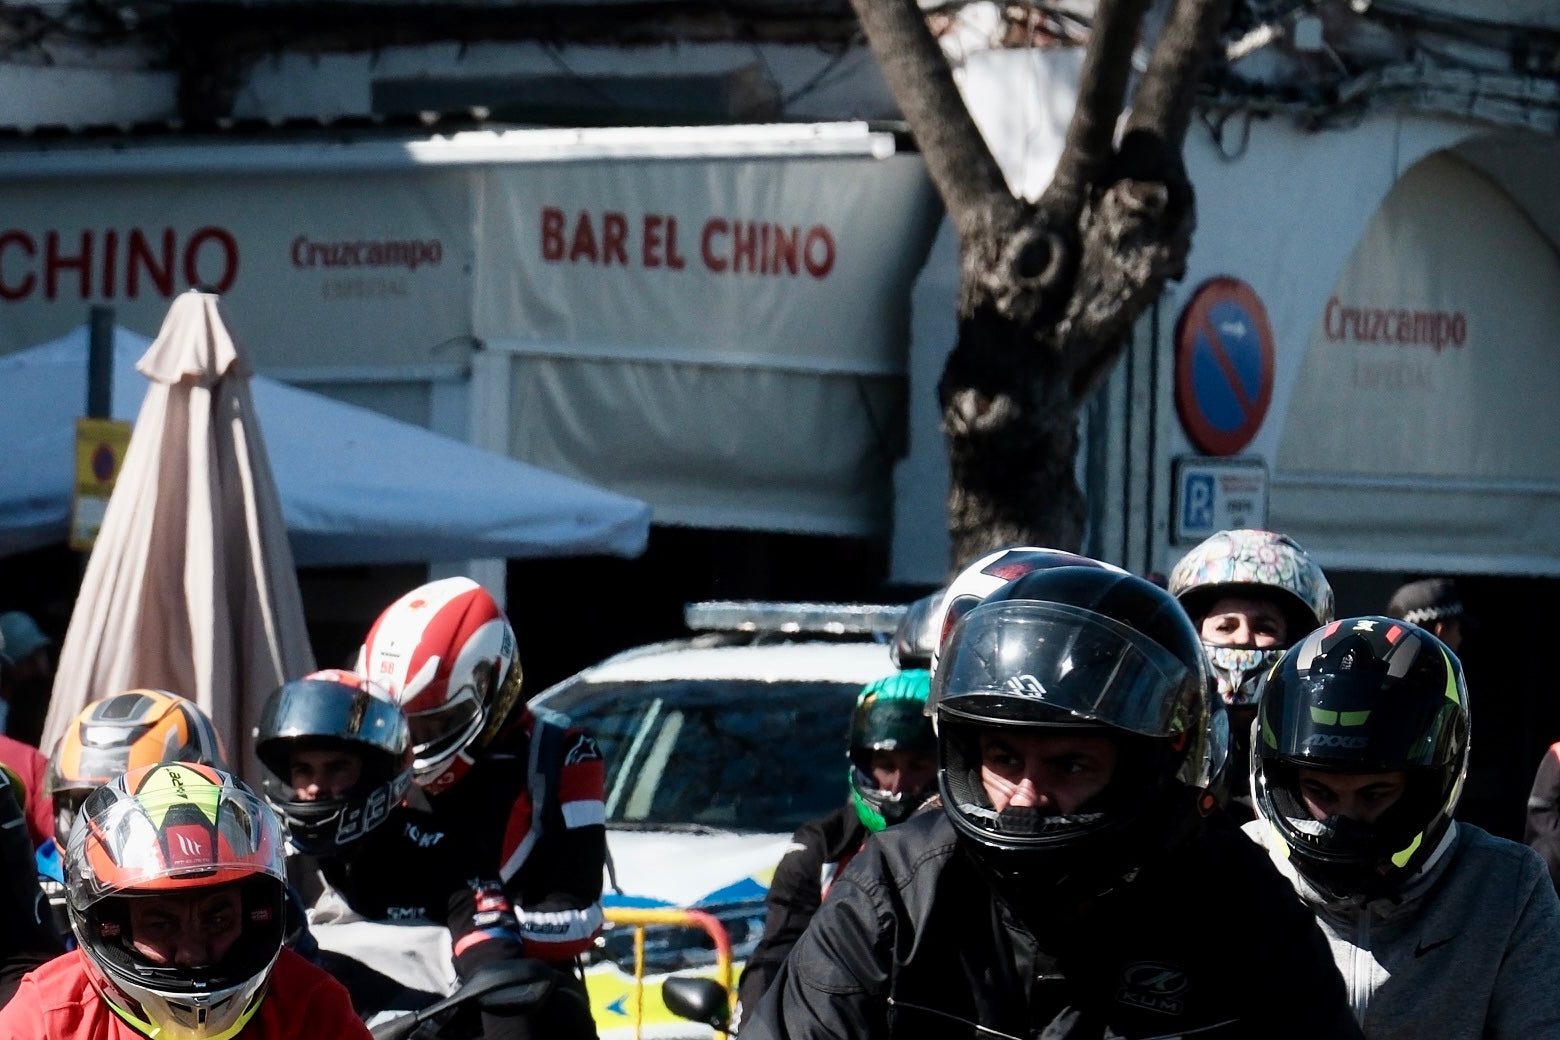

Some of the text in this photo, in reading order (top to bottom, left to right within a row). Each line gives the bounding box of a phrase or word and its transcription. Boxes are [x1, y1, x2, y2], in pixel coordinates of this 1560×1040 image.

[290, 234, 442, 270] Cruzcampo
[542, 208, 836, 280] BAR EL CHINO
[1324, 296, 1467, 352] Cruzcampo
